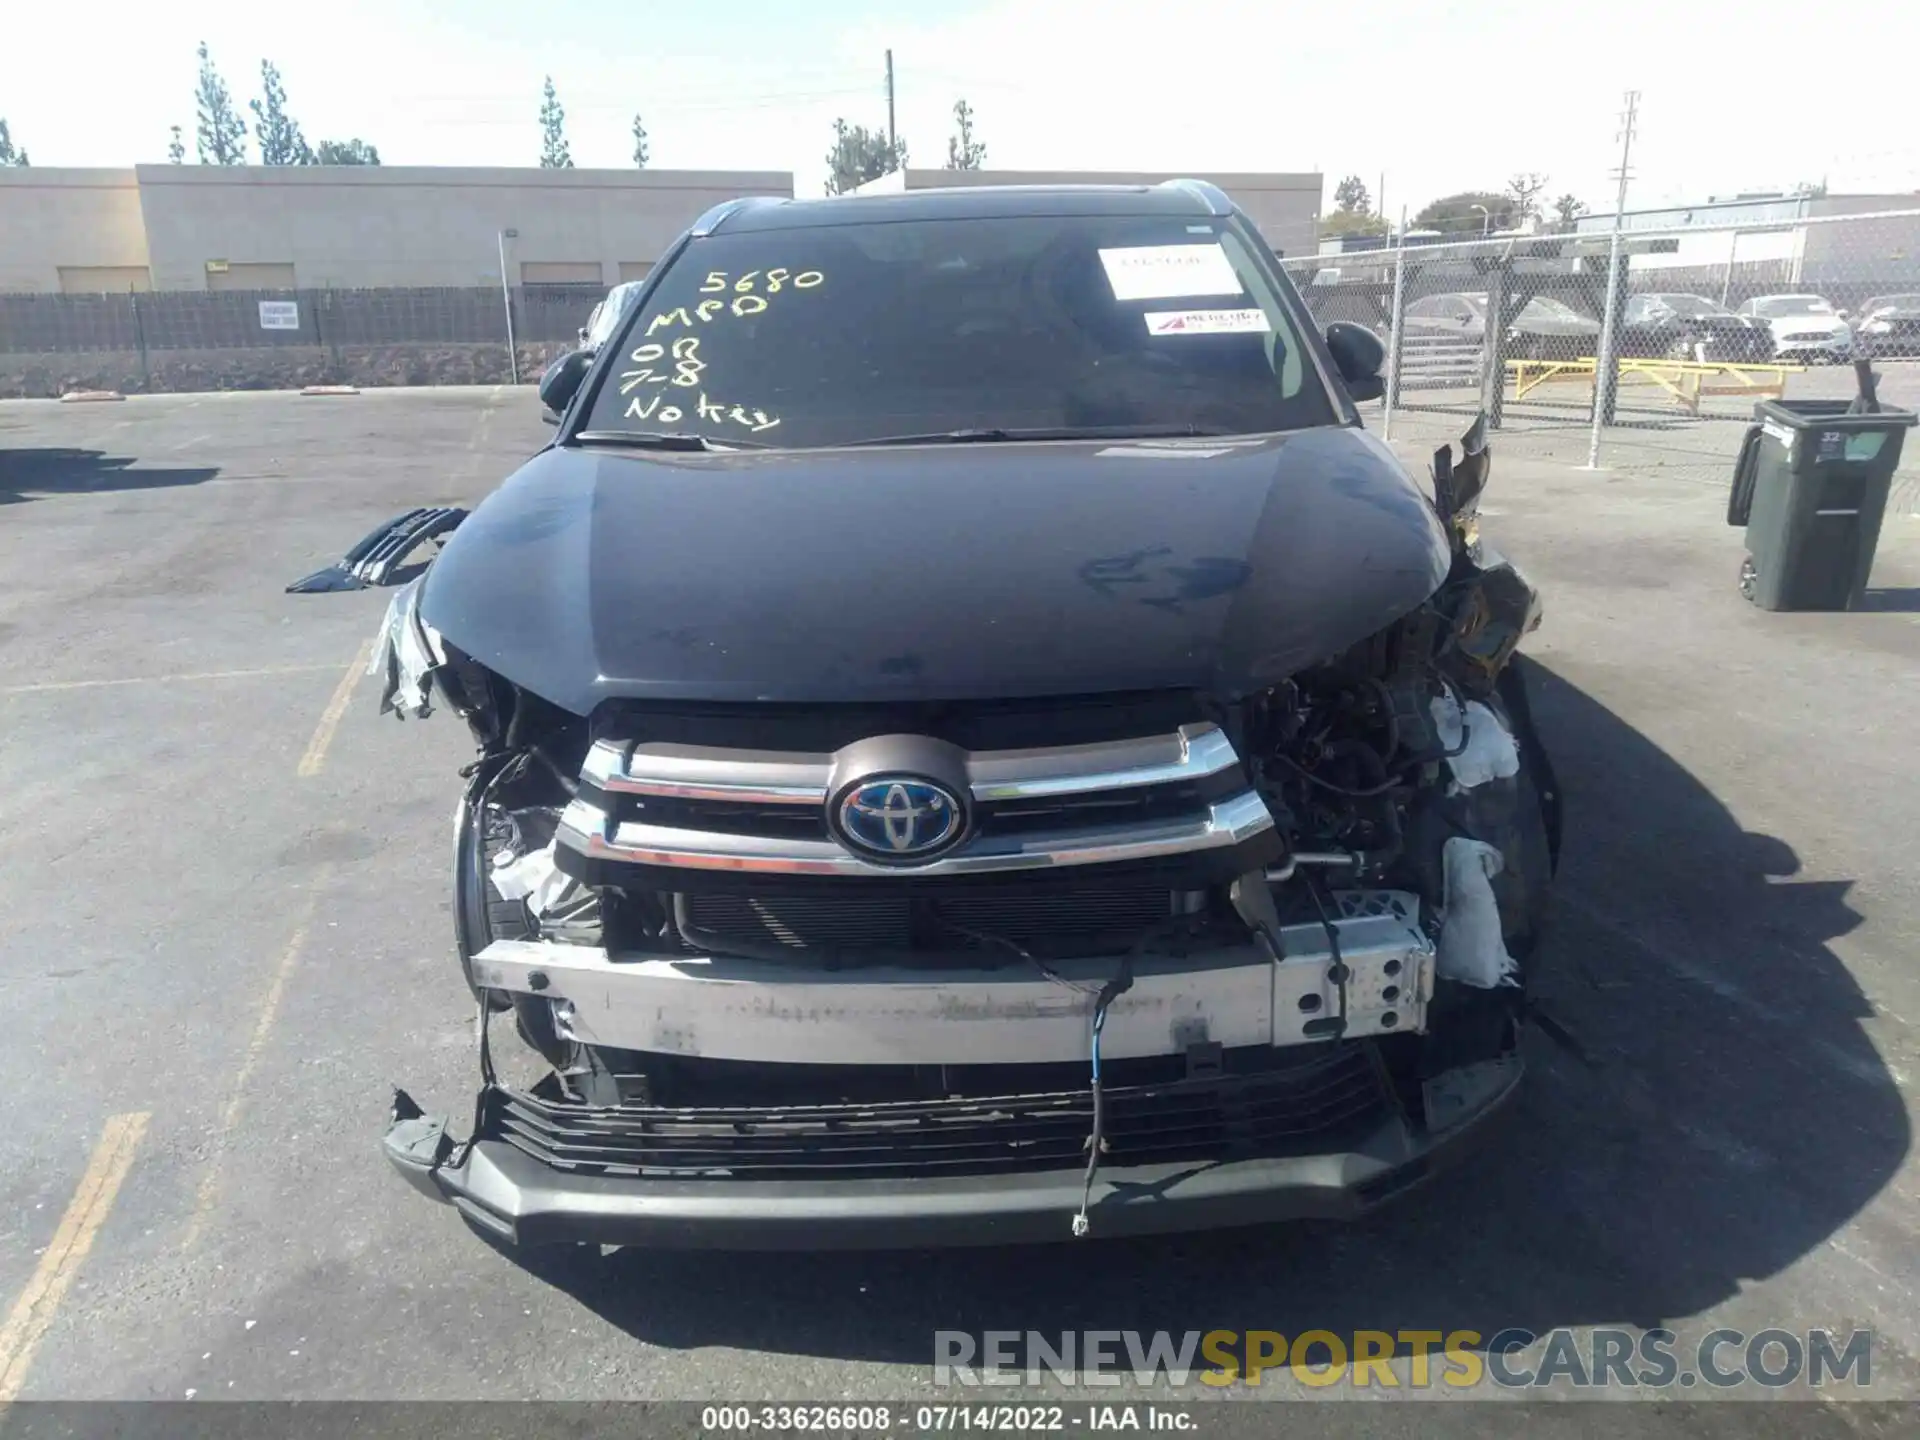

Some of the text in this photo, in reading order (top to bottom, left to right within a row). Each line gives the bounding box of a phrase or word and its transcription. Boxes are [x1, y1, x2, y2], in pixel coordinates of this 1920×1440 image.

[699, 268, 824, 293] 5680
[619, 359, 707, 395] 7-8
[623, 396, 683, 423] No
[1822, 431, 1840, 442] 32
